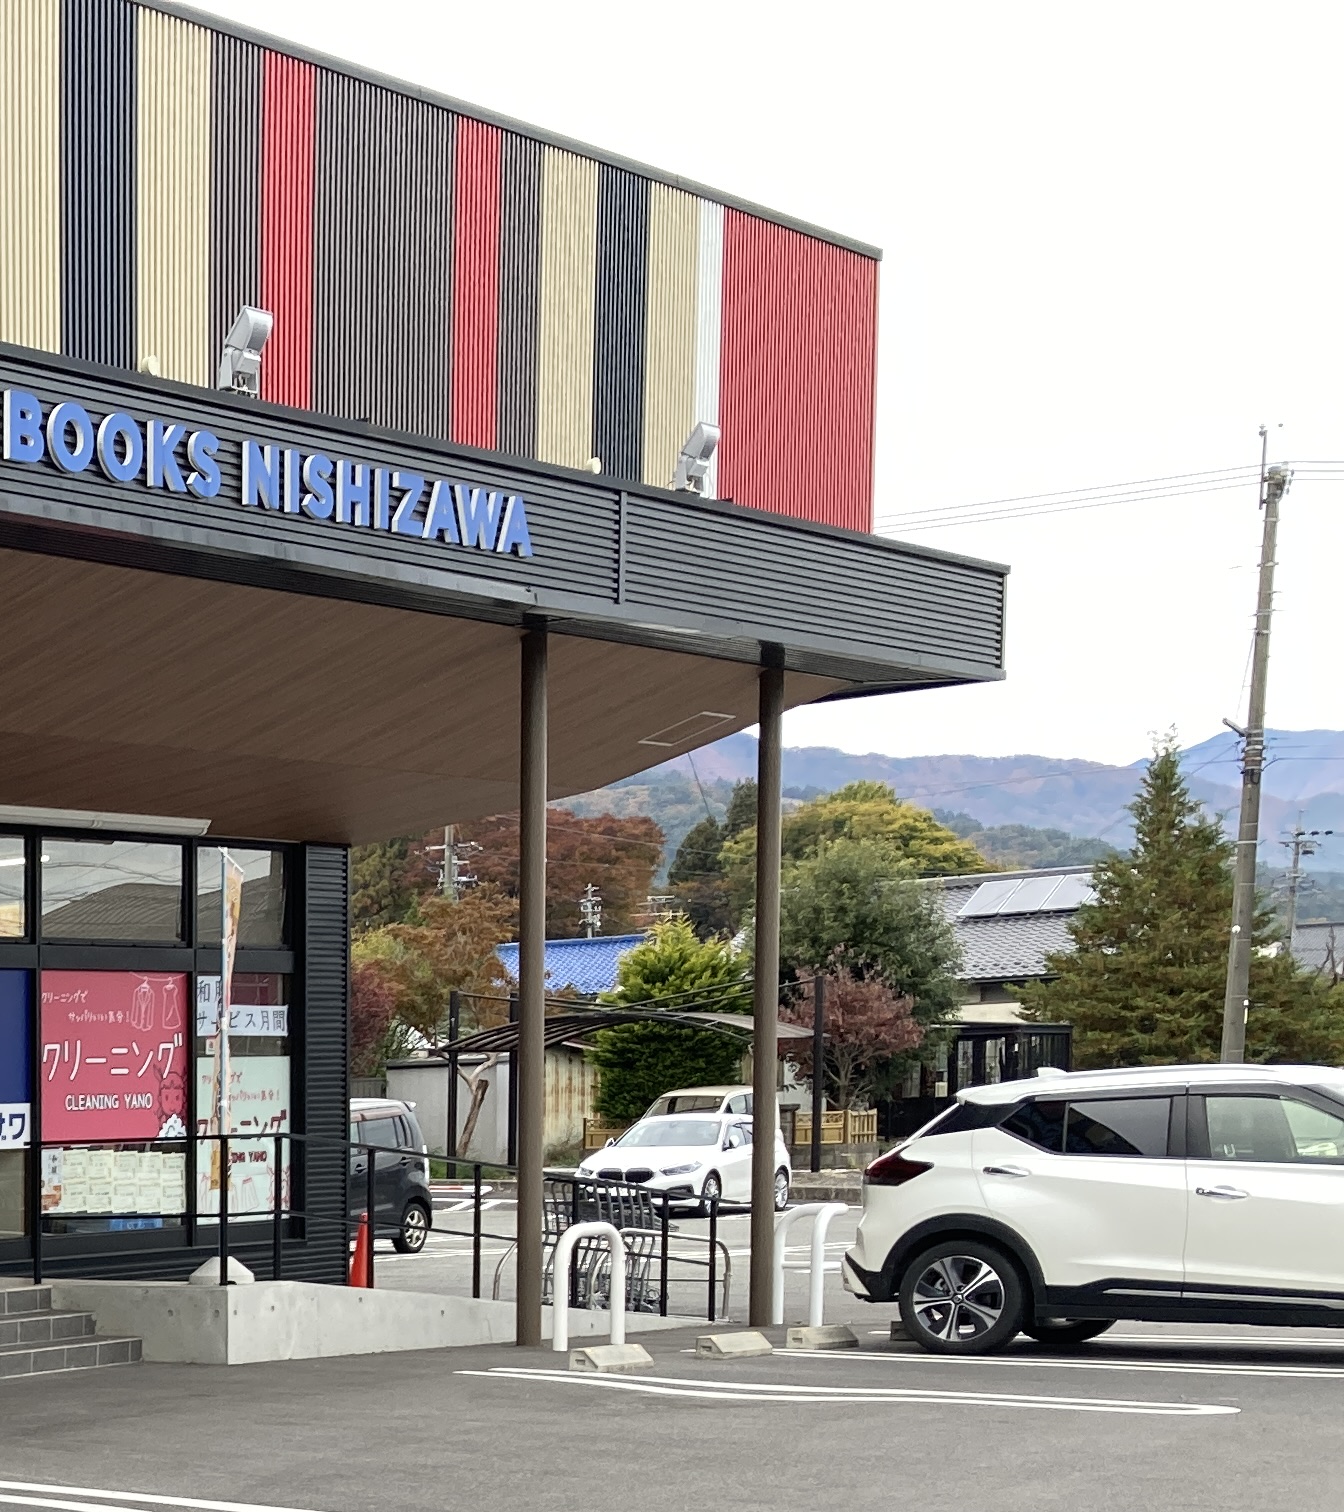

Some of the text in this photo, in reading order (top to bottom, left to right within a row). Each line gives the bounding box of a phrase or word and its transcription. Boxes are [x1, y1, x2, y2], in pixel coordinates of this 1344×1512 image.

[3, 387, 534, 557] BOOKS NISHIZAWA
[43, 1033, 182, 1081] クリーニング
[65, 1092, 153, 1111] CLEANING YANO
